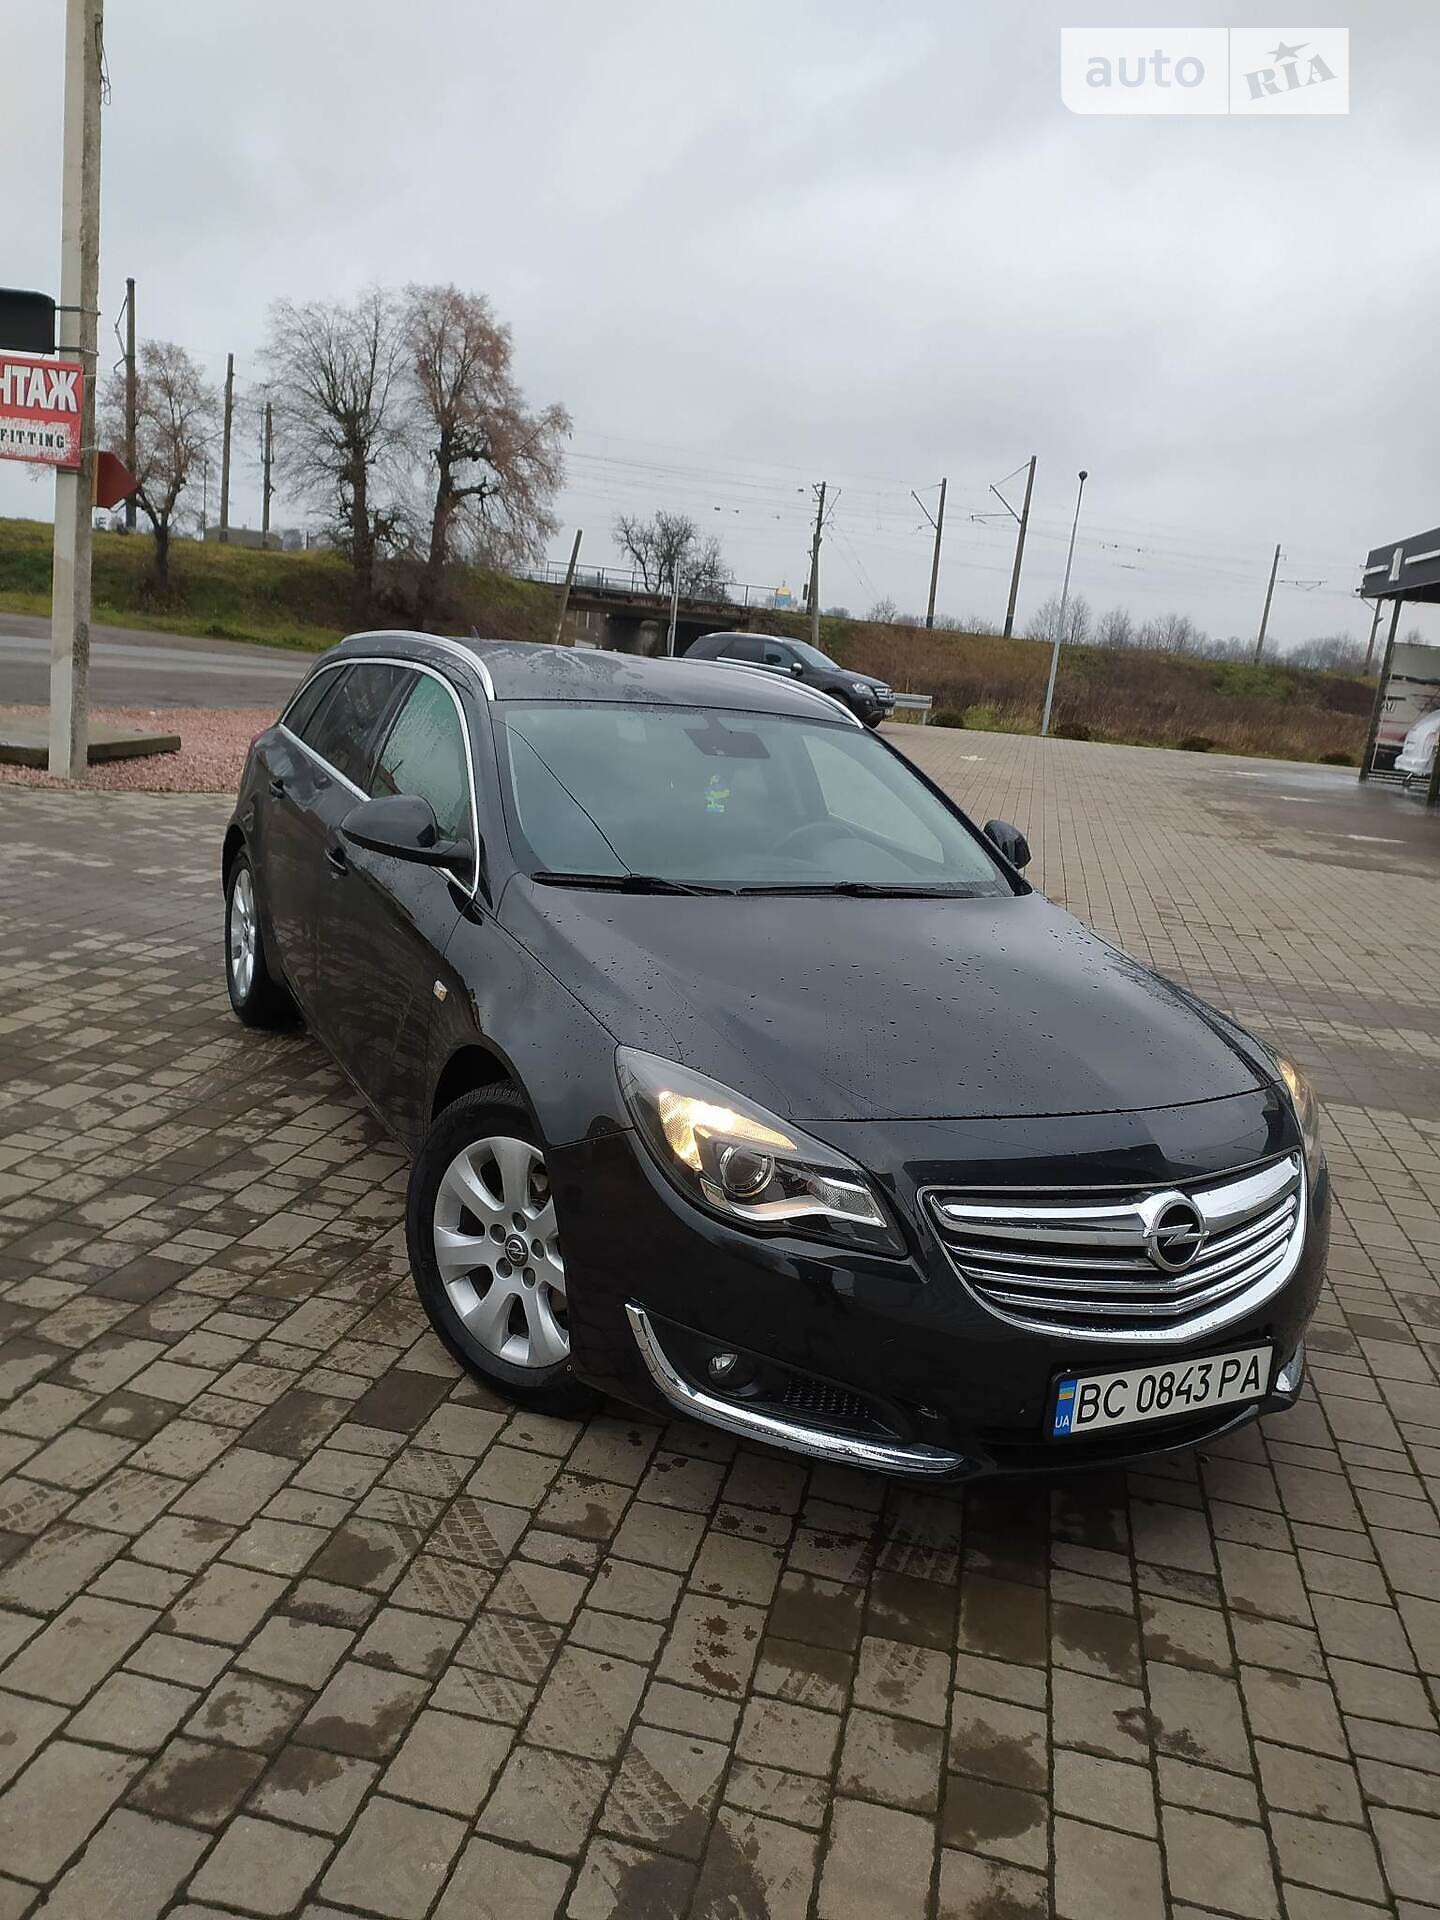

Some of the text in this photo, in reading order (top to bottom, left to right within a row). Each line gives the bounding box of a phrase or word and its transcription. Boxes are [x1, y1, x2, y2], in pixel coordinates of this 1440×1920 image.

[0, 429, 65, 448] FITTING
[1077, 1355, 1260, 1424] BC 0843 PA
[1055, 1415, 1070, 1428] UA
